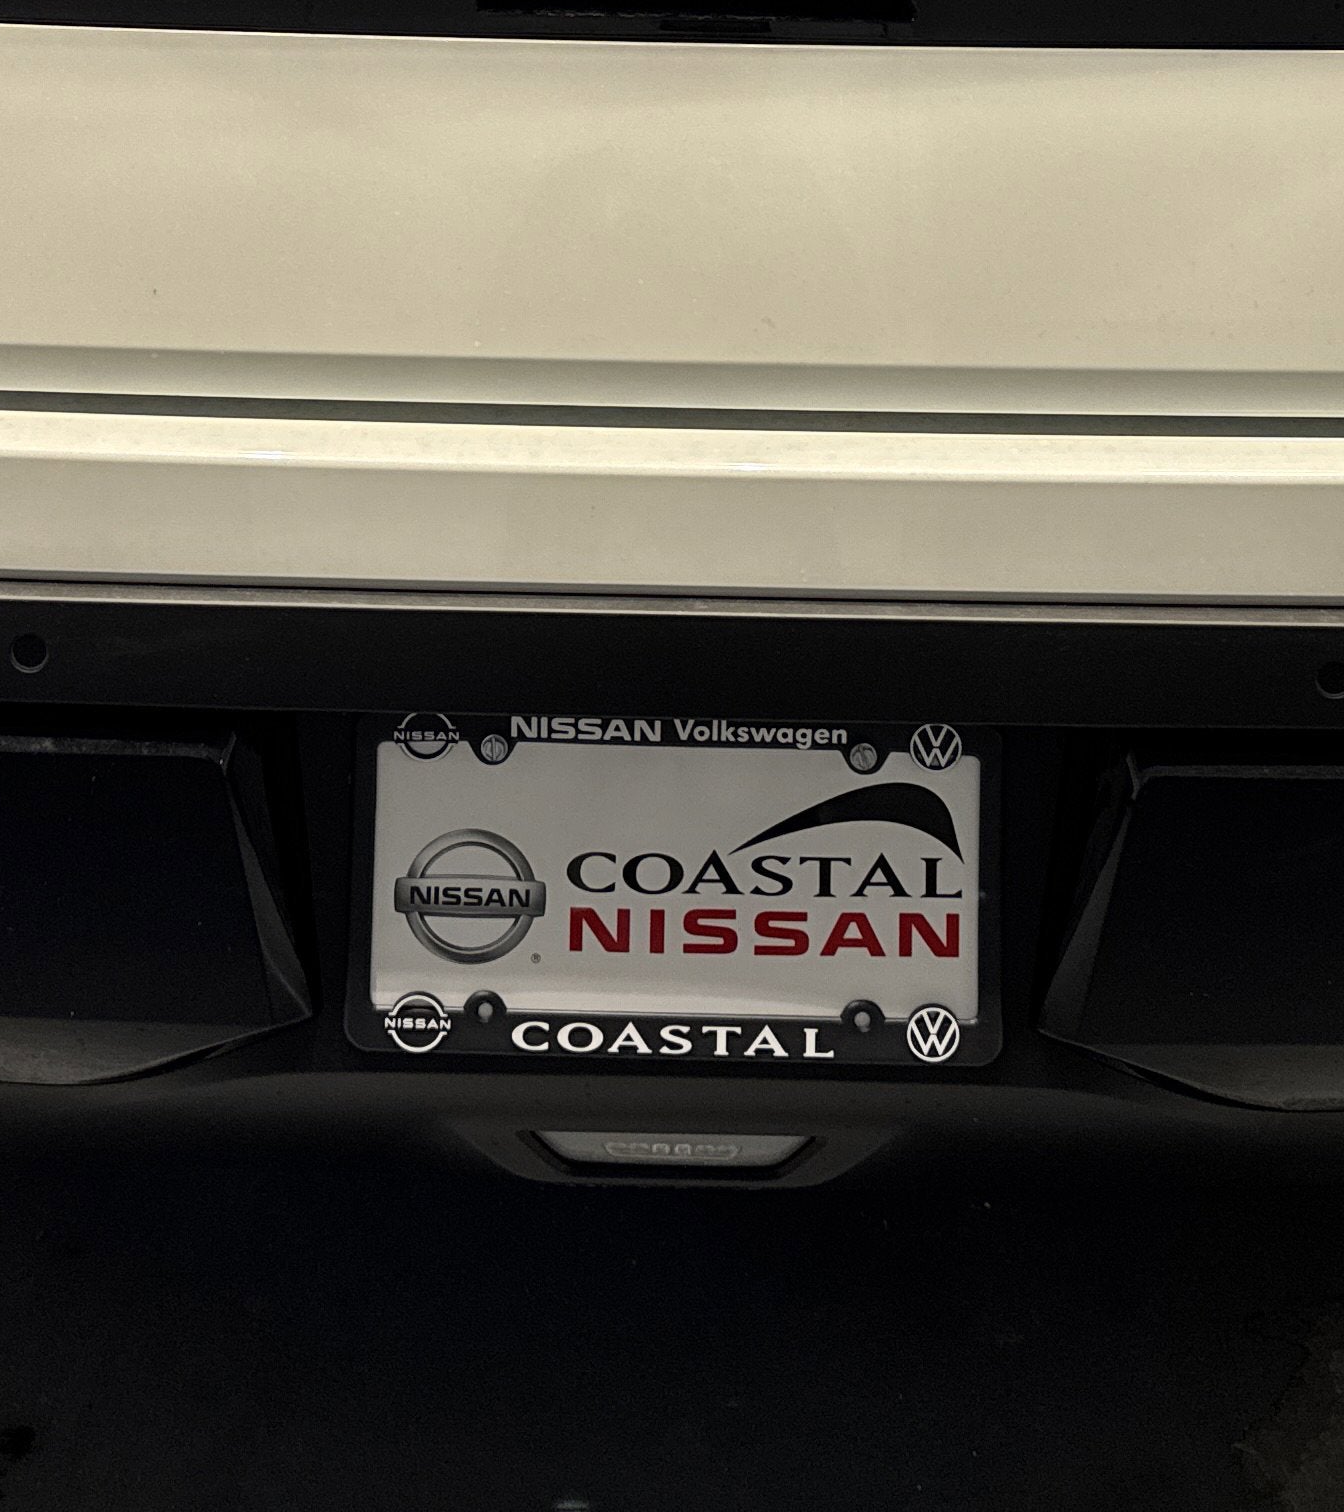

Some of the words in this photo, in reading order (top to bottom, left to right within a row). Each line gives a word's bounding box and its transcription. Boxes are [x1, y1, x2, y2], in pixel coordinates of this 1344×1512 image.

[394, 731, 460, 741] NISSAN
[511, 716, 662, 742] NISSAN
[673, 718, 848, 750] Volkswagen
[566, 851, 963, 899] COASTAL
[409, 885, 532, 909] NISSAN
[568, 907, 960, 958] NISSAN
[384, 1017, 452, 1030] NISSAN
[511, 1021, 835, 1059] COASTAL
